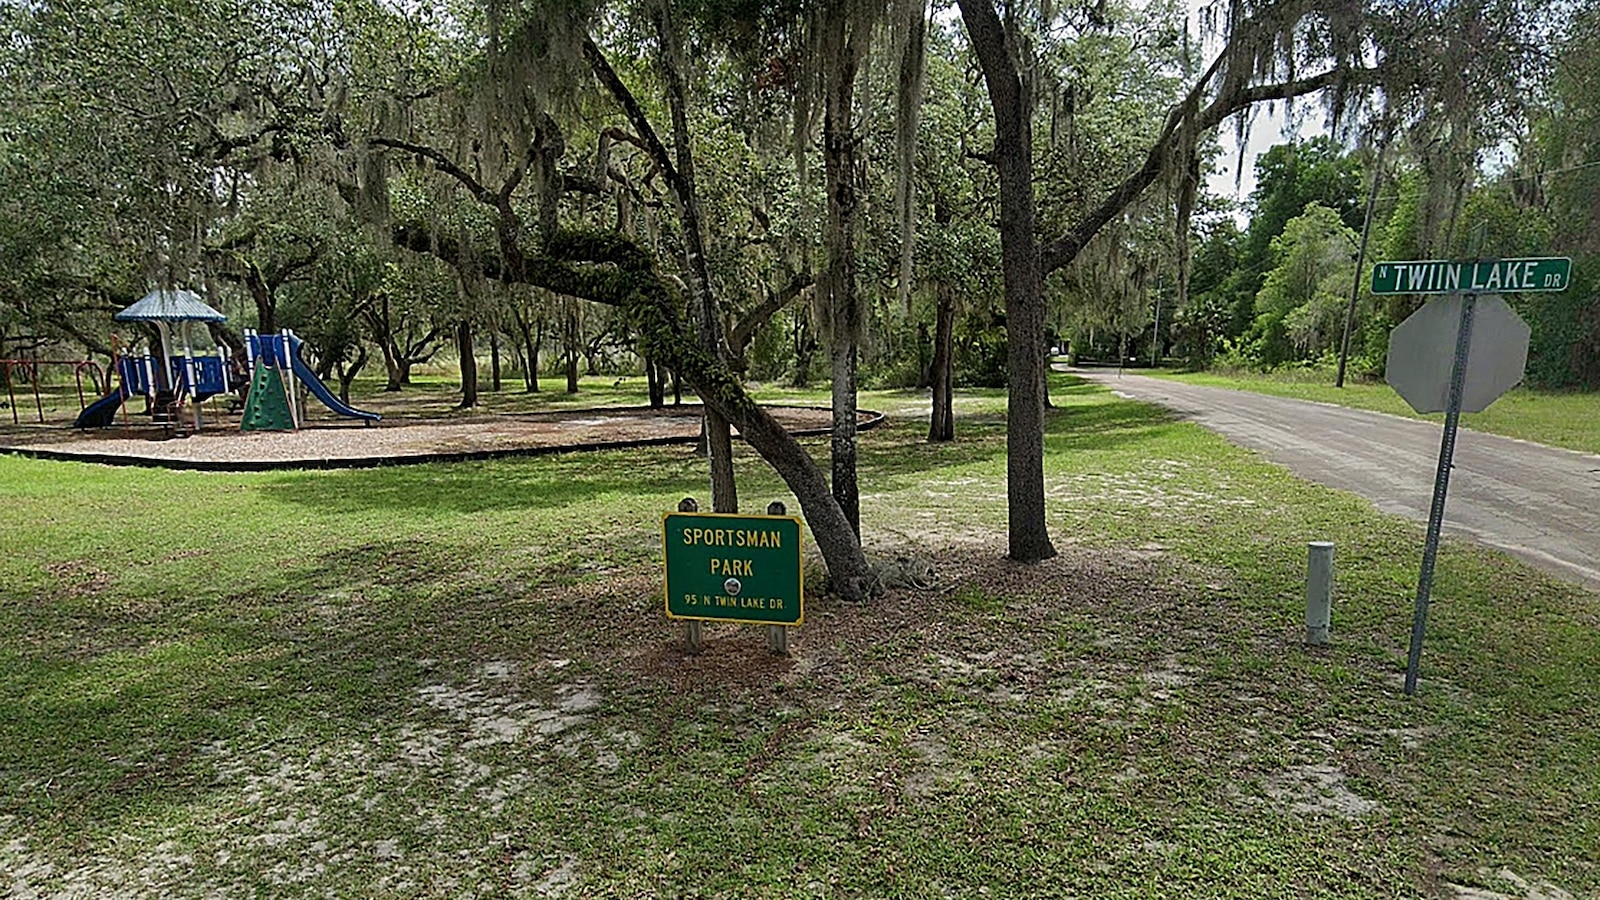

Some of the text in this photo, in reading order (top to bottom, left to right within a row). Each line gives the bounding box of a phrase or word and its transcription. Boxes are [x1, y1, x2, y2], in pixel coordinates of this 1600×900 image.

[1379, 265, 1388, 278] N
[1471, 262, 1539, 290] LAKE
[1544, 273, 1561, 288] DR
[683, 528, 781, 548] SPORTSMAN
[710, 558, 753, 577] PARK
[684, 594, 697, 605] 95
[703, 595, 711, 606] N
[714, 596, 737, 607] TWIN
[741, 597, 765, 609] LAKE
